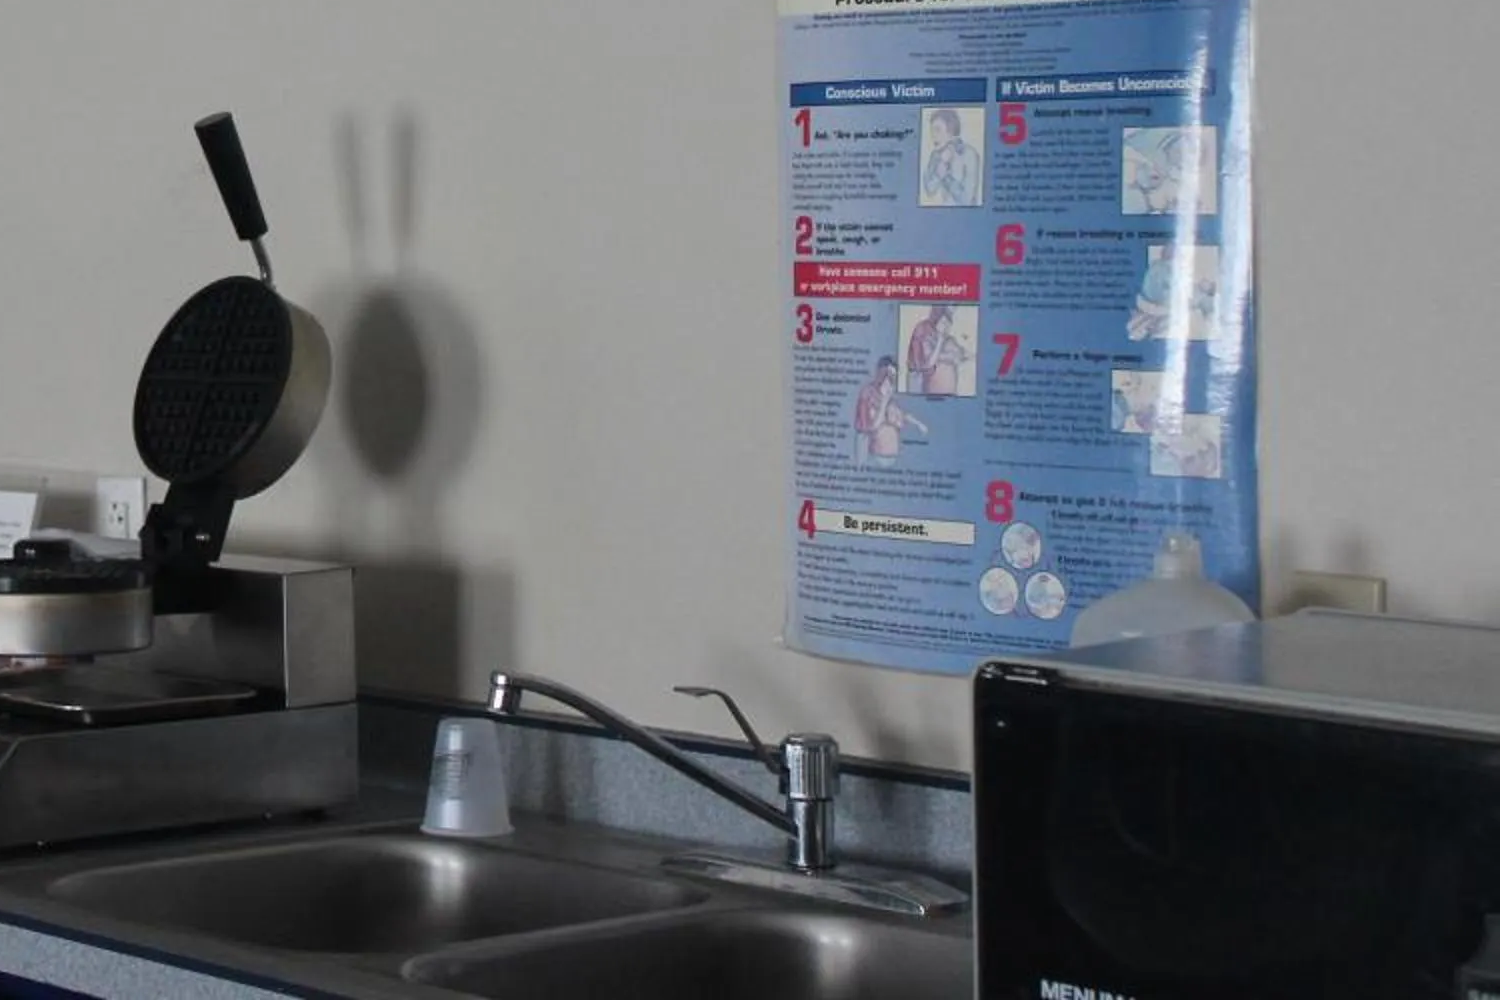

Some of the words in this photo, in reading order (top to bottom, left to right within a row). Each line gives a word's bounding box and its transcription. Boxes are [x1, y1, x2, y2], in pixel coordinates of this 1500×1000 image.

[825, 84, 886, 100] Conscious
[891, 82, 936, 98] Victim
[1001, 81, 1013, 96] If
[1015, 80, 1055, 96] Victim
[1059, 77, 1114, 94] Becomes
[794, 107, 812, 148] 1
[999, 101, 1028, 147] 5
[796, 215, 813, 256] 2
[996, 222, 1026, 266] 6
[858, 282, 917, 297] emergency
[891, 265, 911, 278] call
[914, 265, 938, 279] 911
[796, 303, 813, 344] 3
[992, 333, 1020, 377] 7
[798, 500, 816, 539] 4
[985, 479, 1014, 524] 8
[844, 515, 858, 529] Be
[862, 519, 928, 537] persistent.
